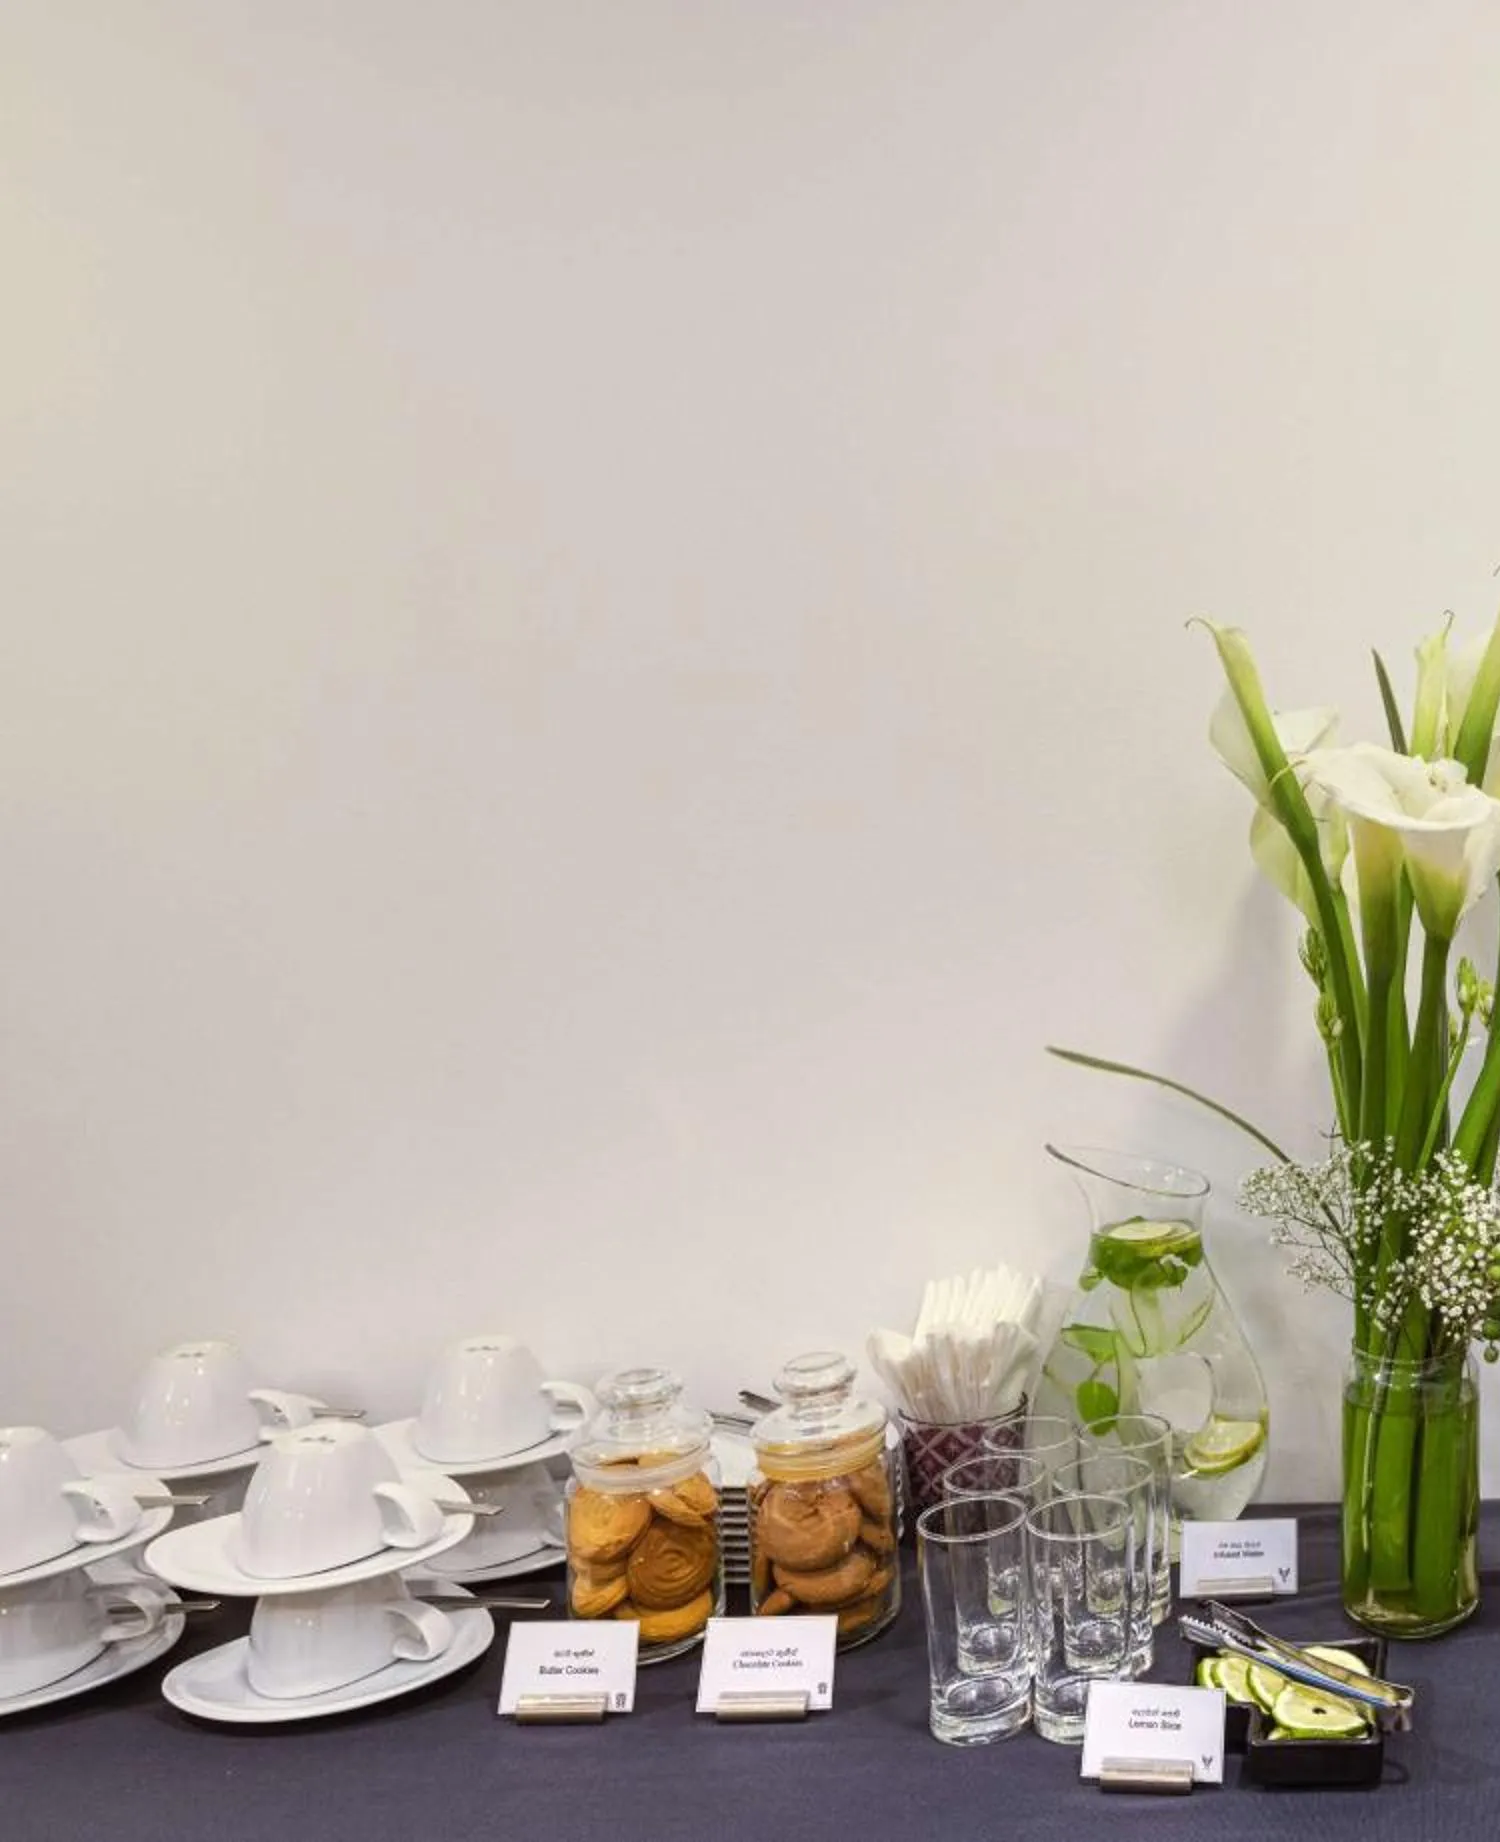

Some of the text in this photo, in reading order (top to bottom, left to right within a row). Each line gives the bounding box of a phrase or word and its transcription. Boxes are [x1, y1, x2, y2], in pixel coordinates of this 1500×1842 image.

[771, 1658, 803, 1668] Cookies
[565, 1664, 600, 1675] Cookies
[1128, 1717, 1159, 1729] Lemon
